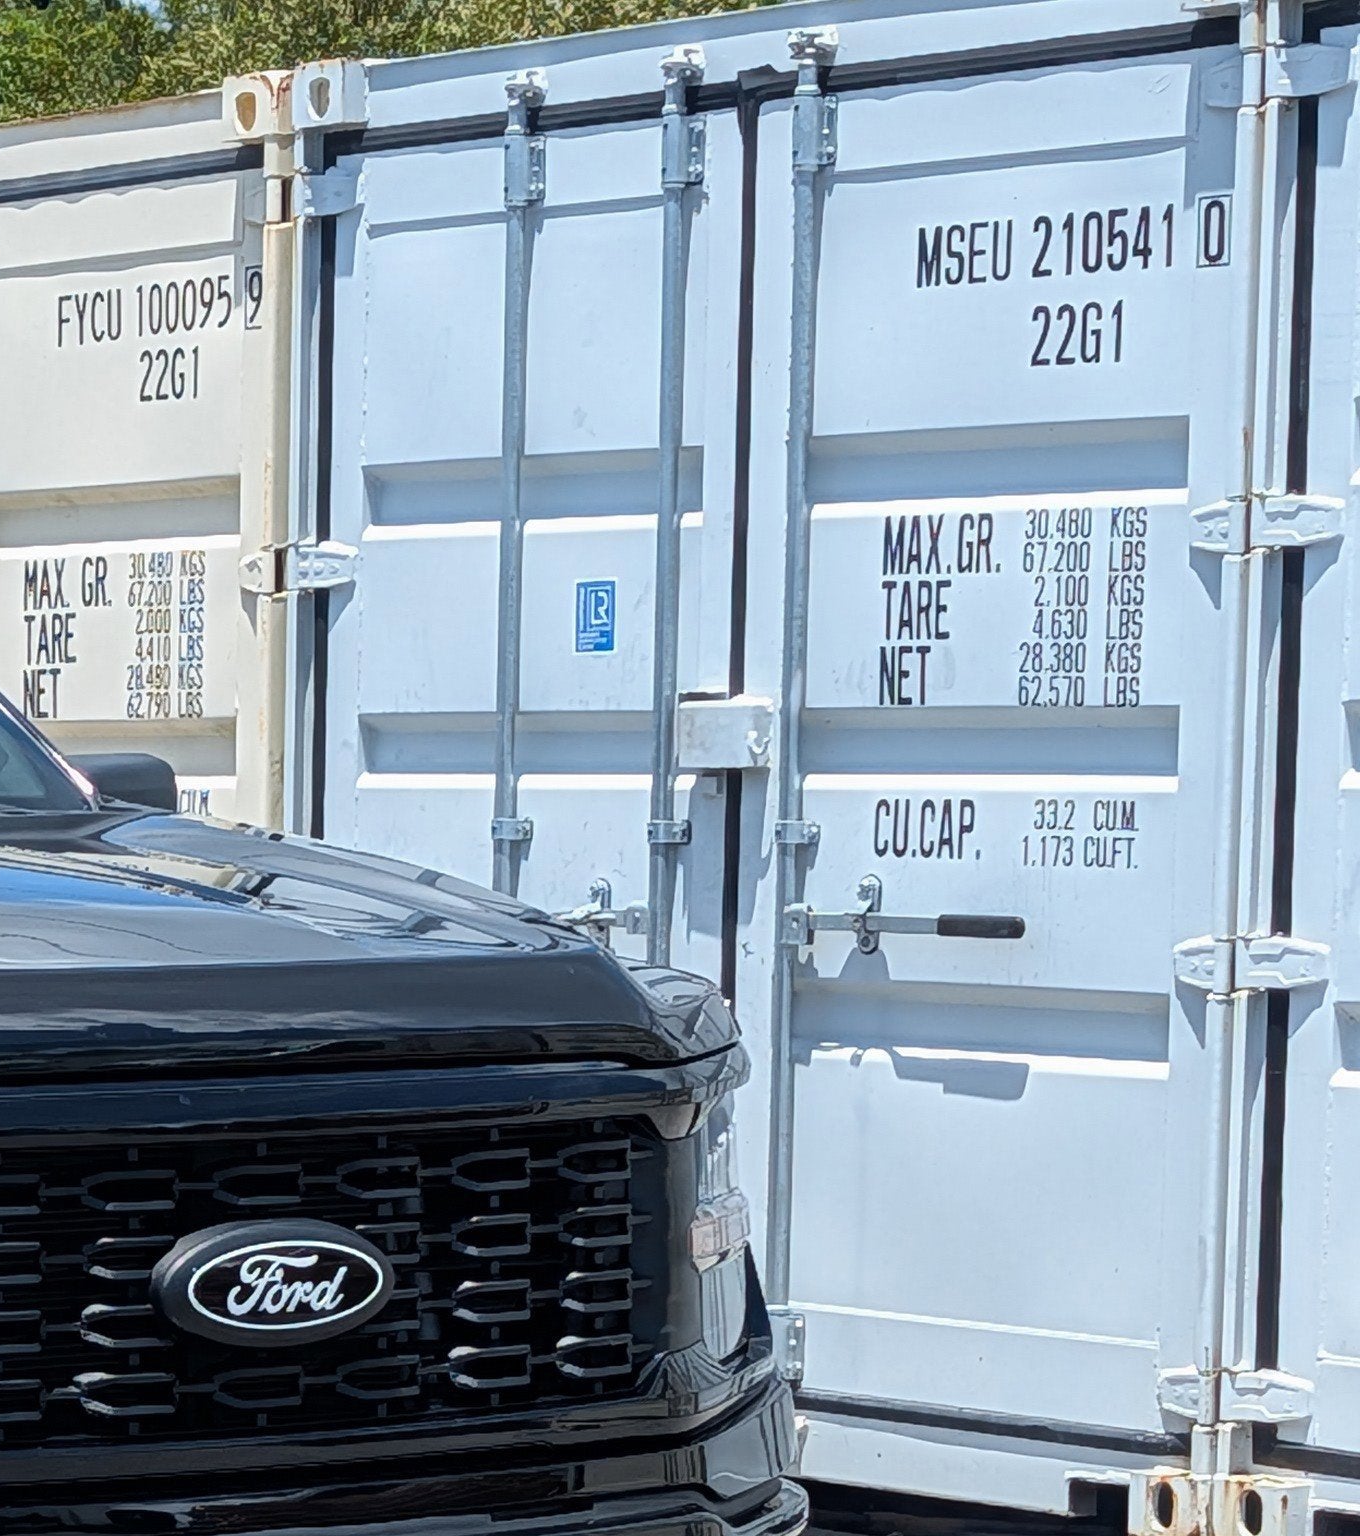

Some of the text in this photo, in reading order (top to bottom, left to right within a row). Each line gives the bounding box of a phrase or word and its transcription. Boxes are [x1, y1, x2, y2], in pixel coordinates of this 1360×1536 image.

[916, 199, 1226, 289] MSEU 210541 0
[57, 270, 263, 348] FYCU 100095 9
[1030, 299, 1124, 368] 22G1
[139, 345, 199, 402] 22G1
[1110, 506, 1148, 538] KGS
[180, 550, 206, 577] KGS
[1108, 540, 1147, 573] LBS
[179, 578, 205, 605] LBS
[882, 580, 953, 640] TARE
[1107, 574, 1146, 607] KGS
[24, 612, 77, 666] TARE
[179, 606, 204, 634] KGS
[178, 634, 204, 661] LBS
[1105, 608, 1143, 640] LBS
[23, 668, 61, 719] NET
[177, 663, 203, 690] KGS
[879, 645, 932, 706] NET
[1104, 642, 1141, 674] KGS
[1103, 676, 1140, 708] LBS
[177, 692, 203, 718] LBS
[874, 798, 982, 861] CU.CAP.
[1033, 798, 1077, 831] 33.2
[226, 1253, 347, 1317] Ford
